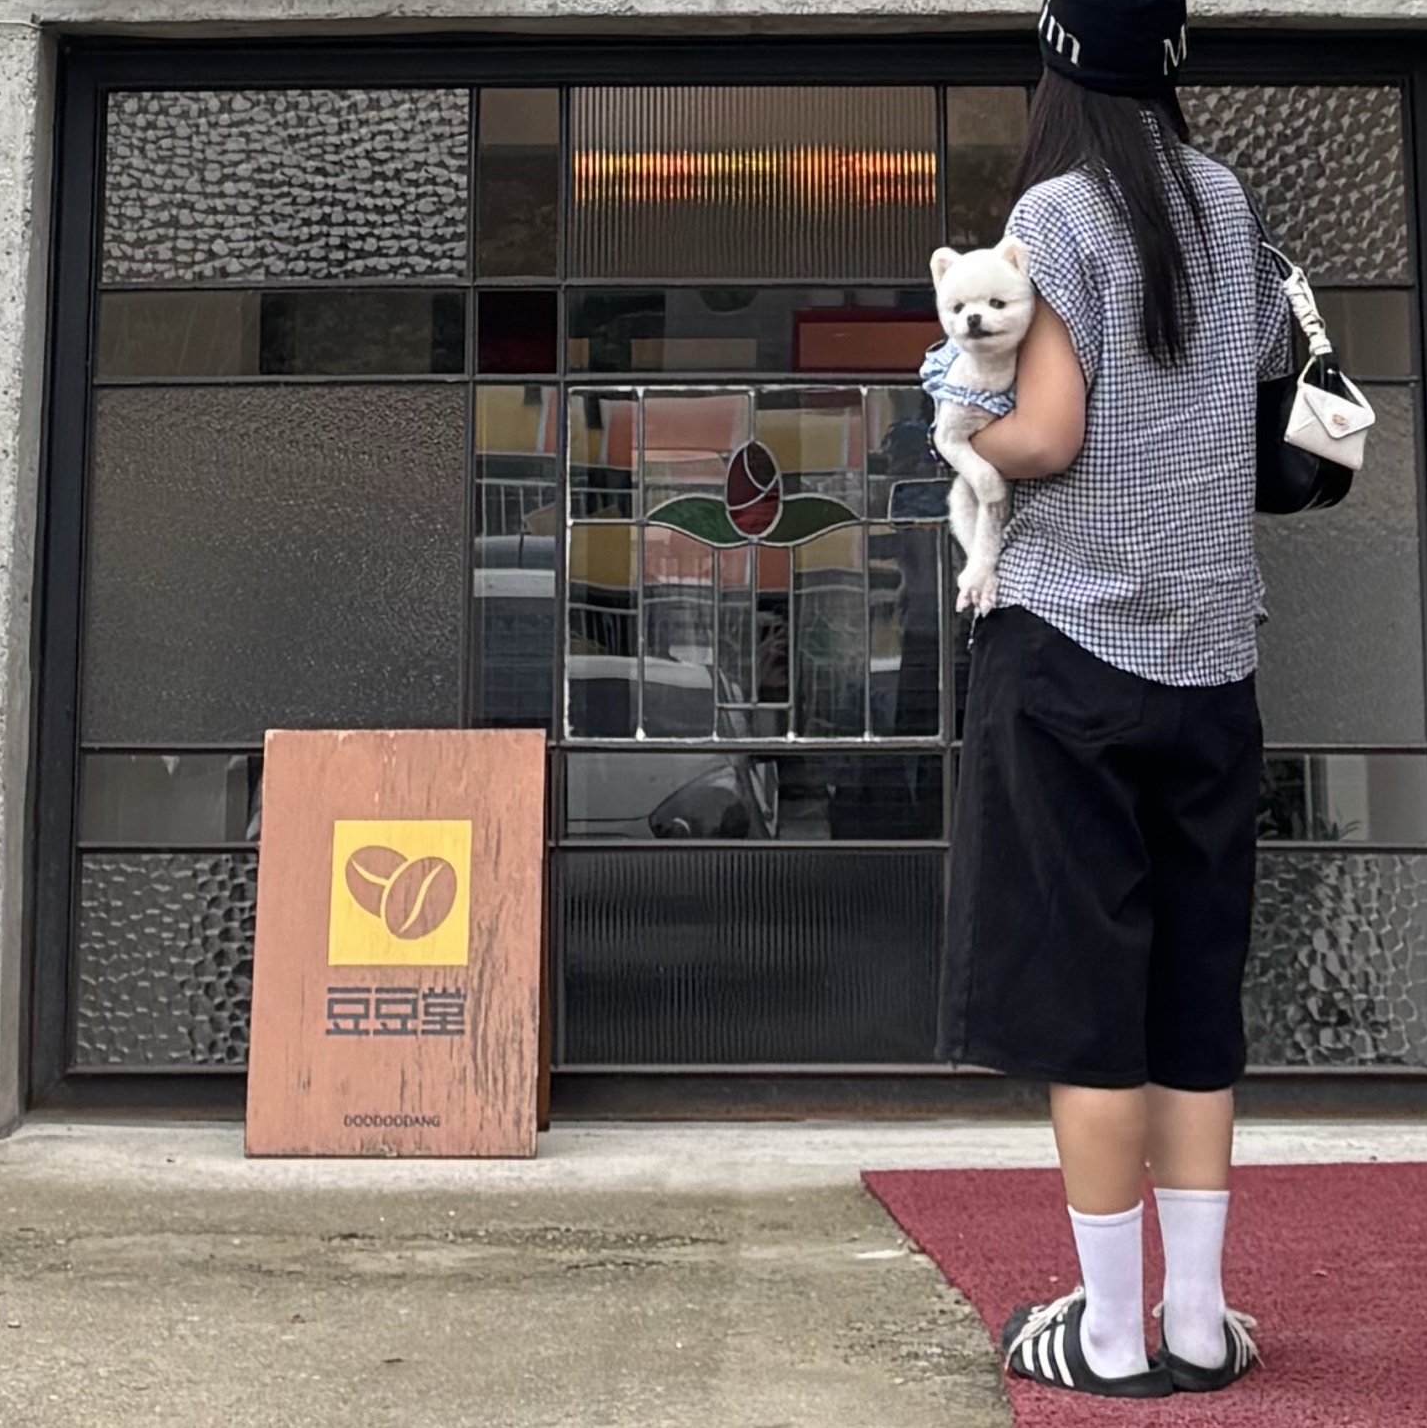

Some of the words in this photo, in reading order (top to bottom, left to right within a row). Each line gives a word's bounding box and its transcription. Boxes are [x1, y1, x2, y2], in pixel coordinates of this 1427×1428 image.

[325, 986, 467, 1036] 豆豆堂
[343, 1113, 440, 1128] DOODOODANG
